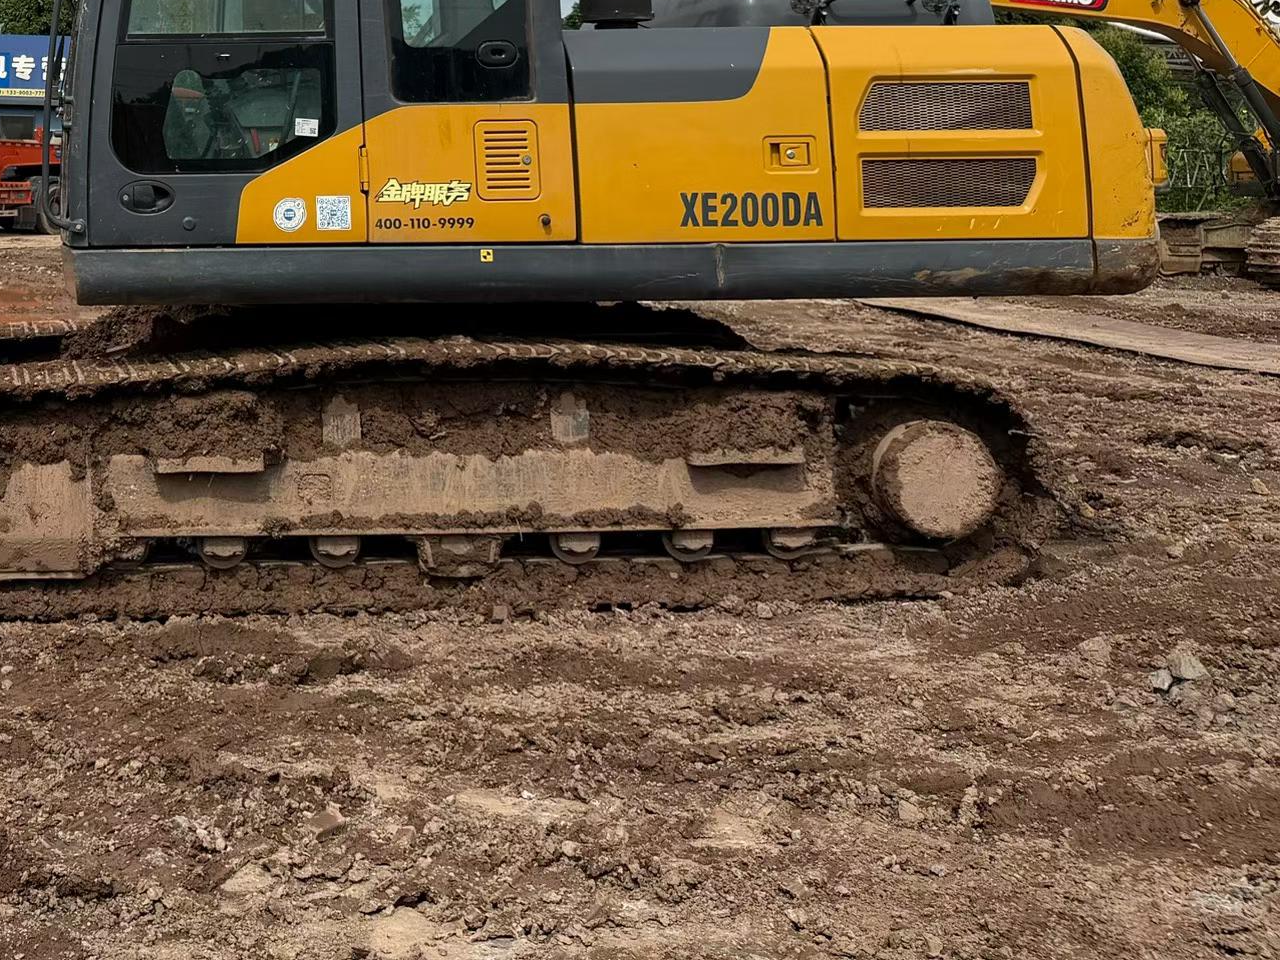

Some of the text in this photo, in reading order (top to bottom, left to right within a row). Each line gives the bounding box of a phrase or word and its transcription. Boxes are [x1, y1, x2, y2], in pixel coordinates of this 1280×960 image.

[375, 177, 472, 209] 金牌服务
[375, 216, 475, 231] 400-110-9999
[679, 192, 823, 228] XE200DA
